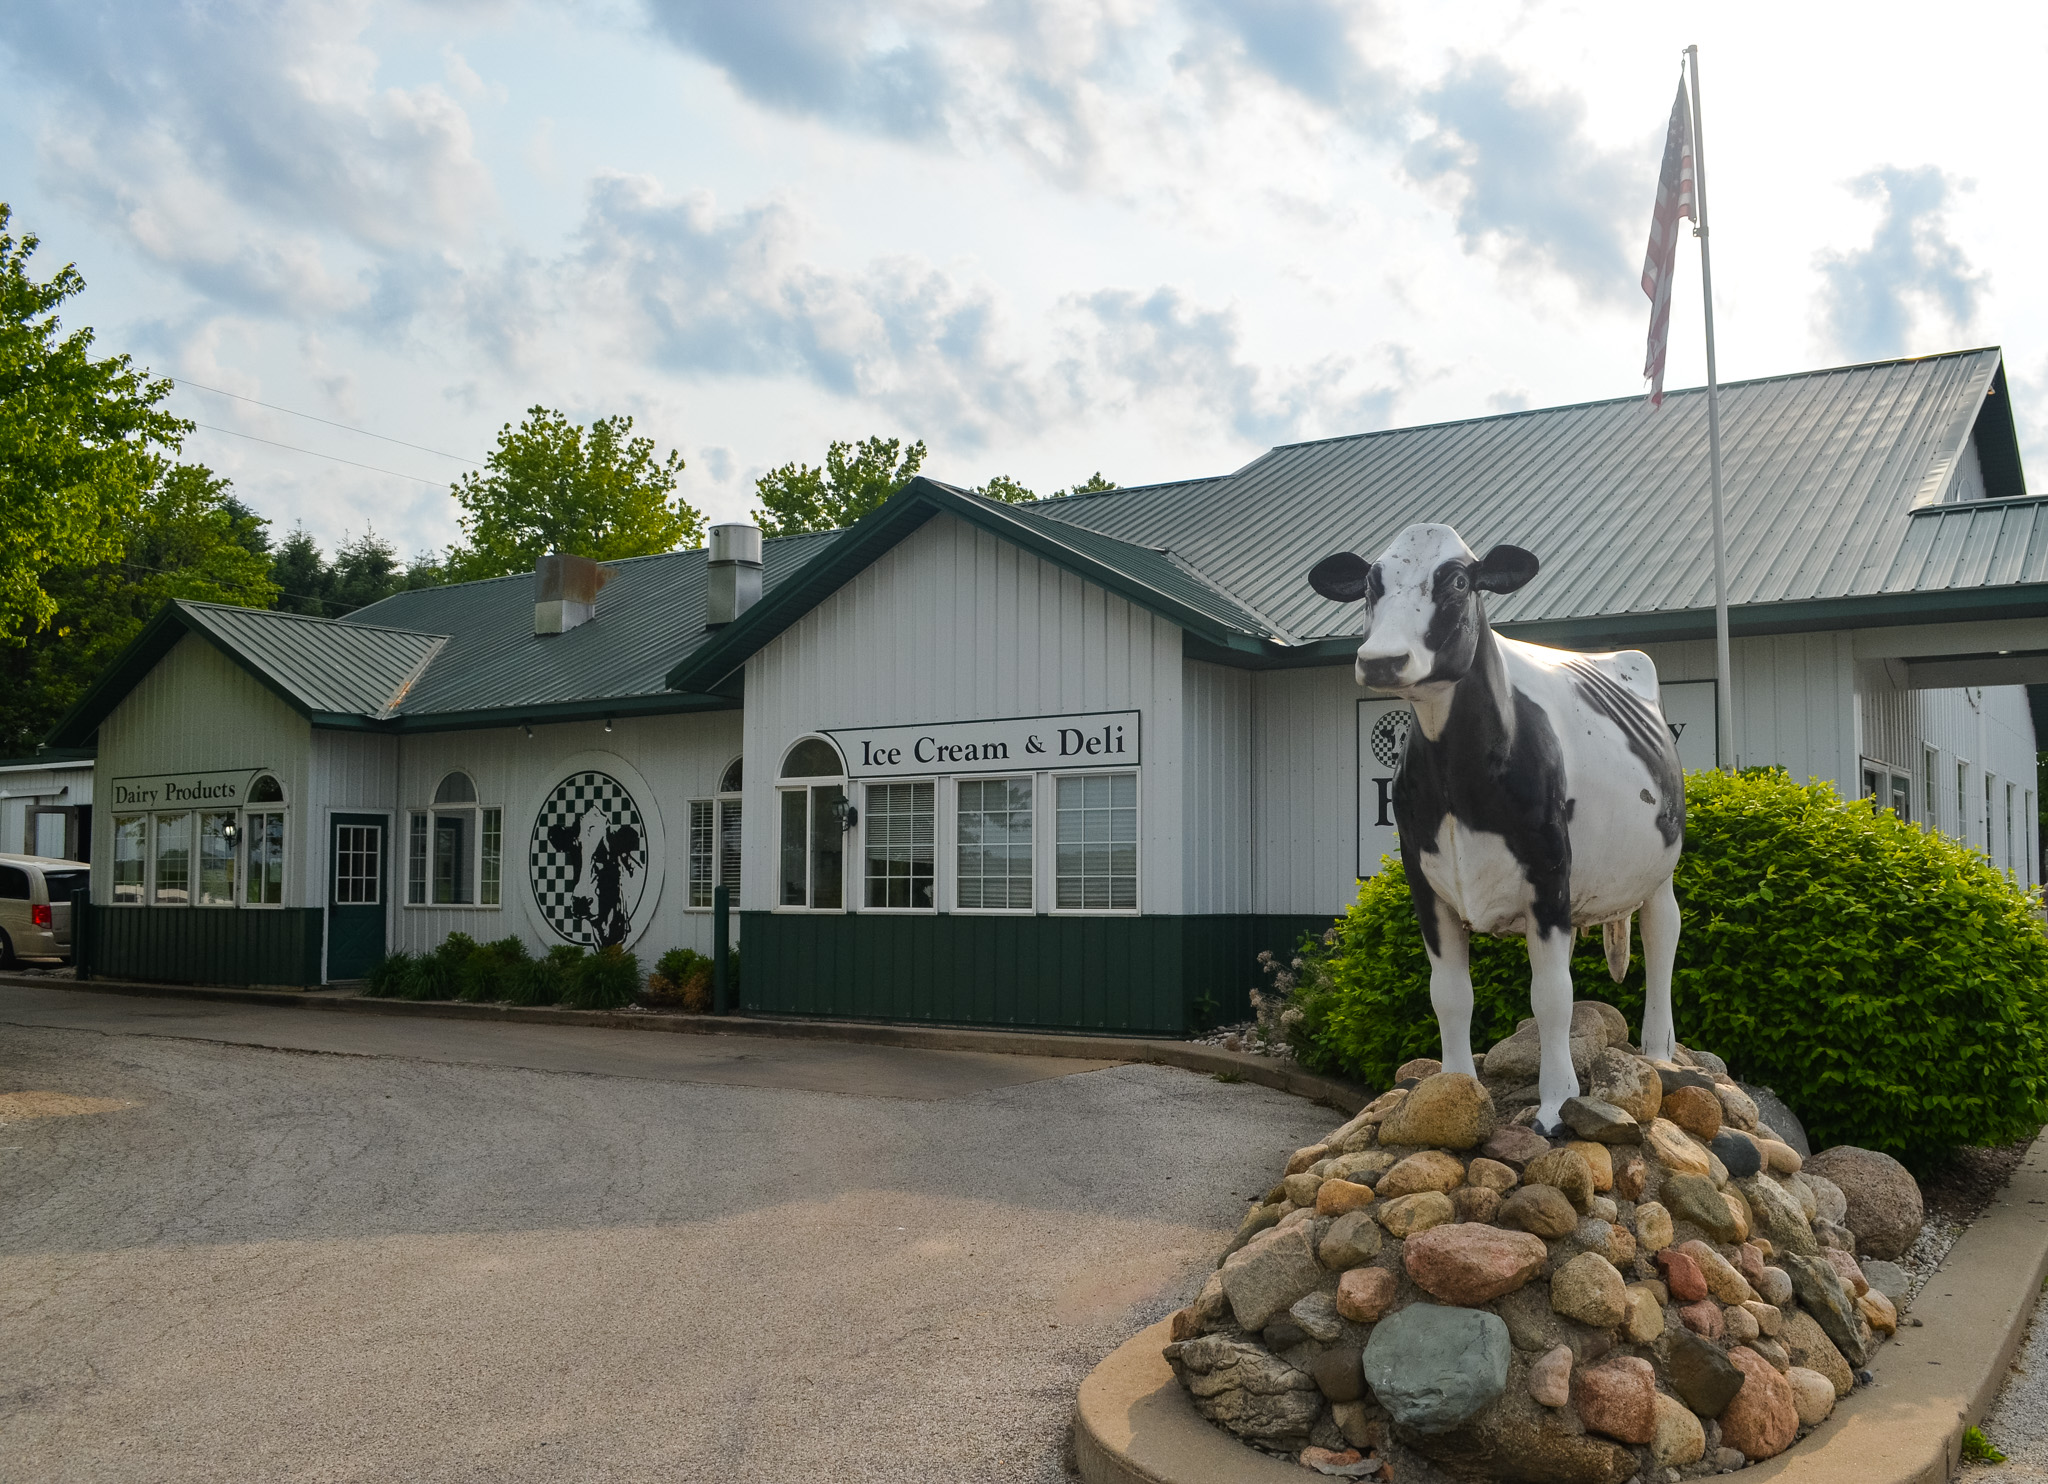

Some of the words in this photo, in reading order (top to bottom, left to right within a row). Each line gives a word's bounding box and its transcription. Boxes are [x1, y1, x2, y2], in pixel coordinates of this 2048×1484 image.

[861, 740, 901, 767] Ice
[914, 736, 1009, 764] Cream
[1025, 734, 1046, 754] &
[1058, 725, 1125, 757] Deli
[115, 785, 158, 807] Dairy
[165, 780, 236, 801] Products
